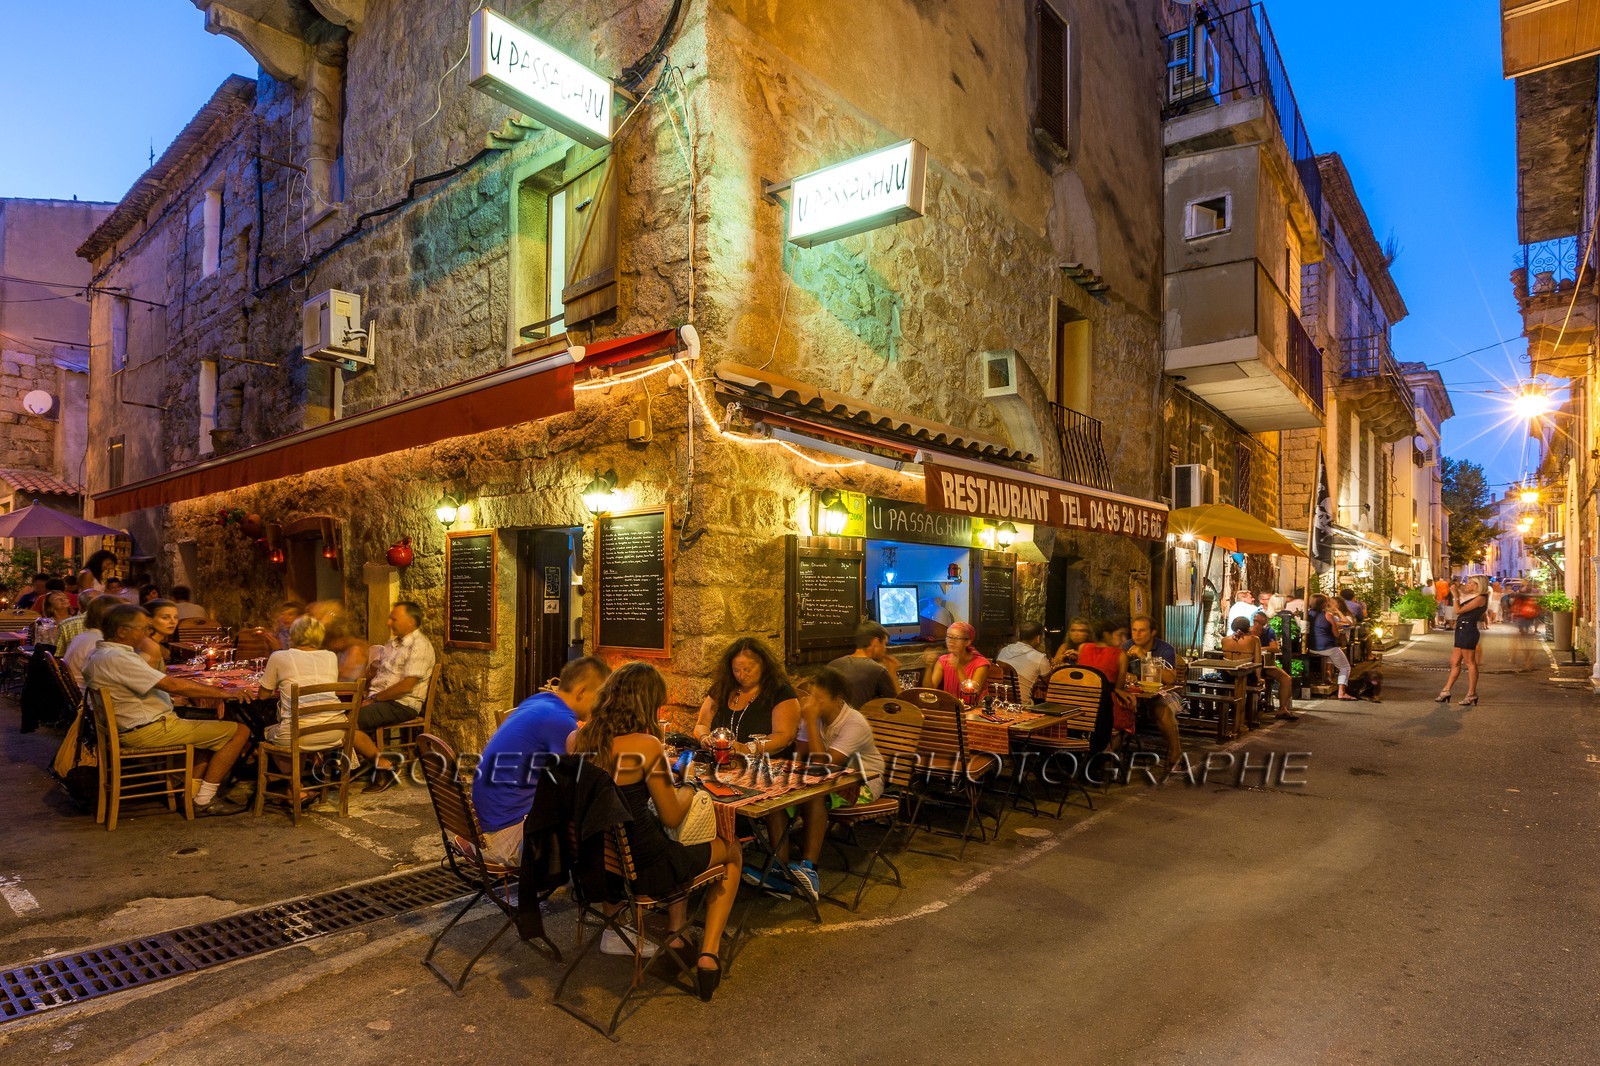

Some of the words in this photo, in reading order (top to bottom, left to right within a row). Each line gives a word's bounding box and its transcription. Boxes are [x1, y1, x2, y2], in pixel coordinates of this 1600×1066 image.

[490, 31, 503, 65] U
[798, 196, 808, 222] U
[941, 471, 1049, 522] RESTAURANT
[1059, 493, 1087, 527] TEL.
[1090, 500, 1104, 529] 04
[1106, 502, 1120, 532] 95
[1122, 506, 1135, 534] 20
[1137, 509, 1149, 537] 15
[1150, 513, 1162, 538] 66
[887, 508, 968, 538] PASSAGHJU
